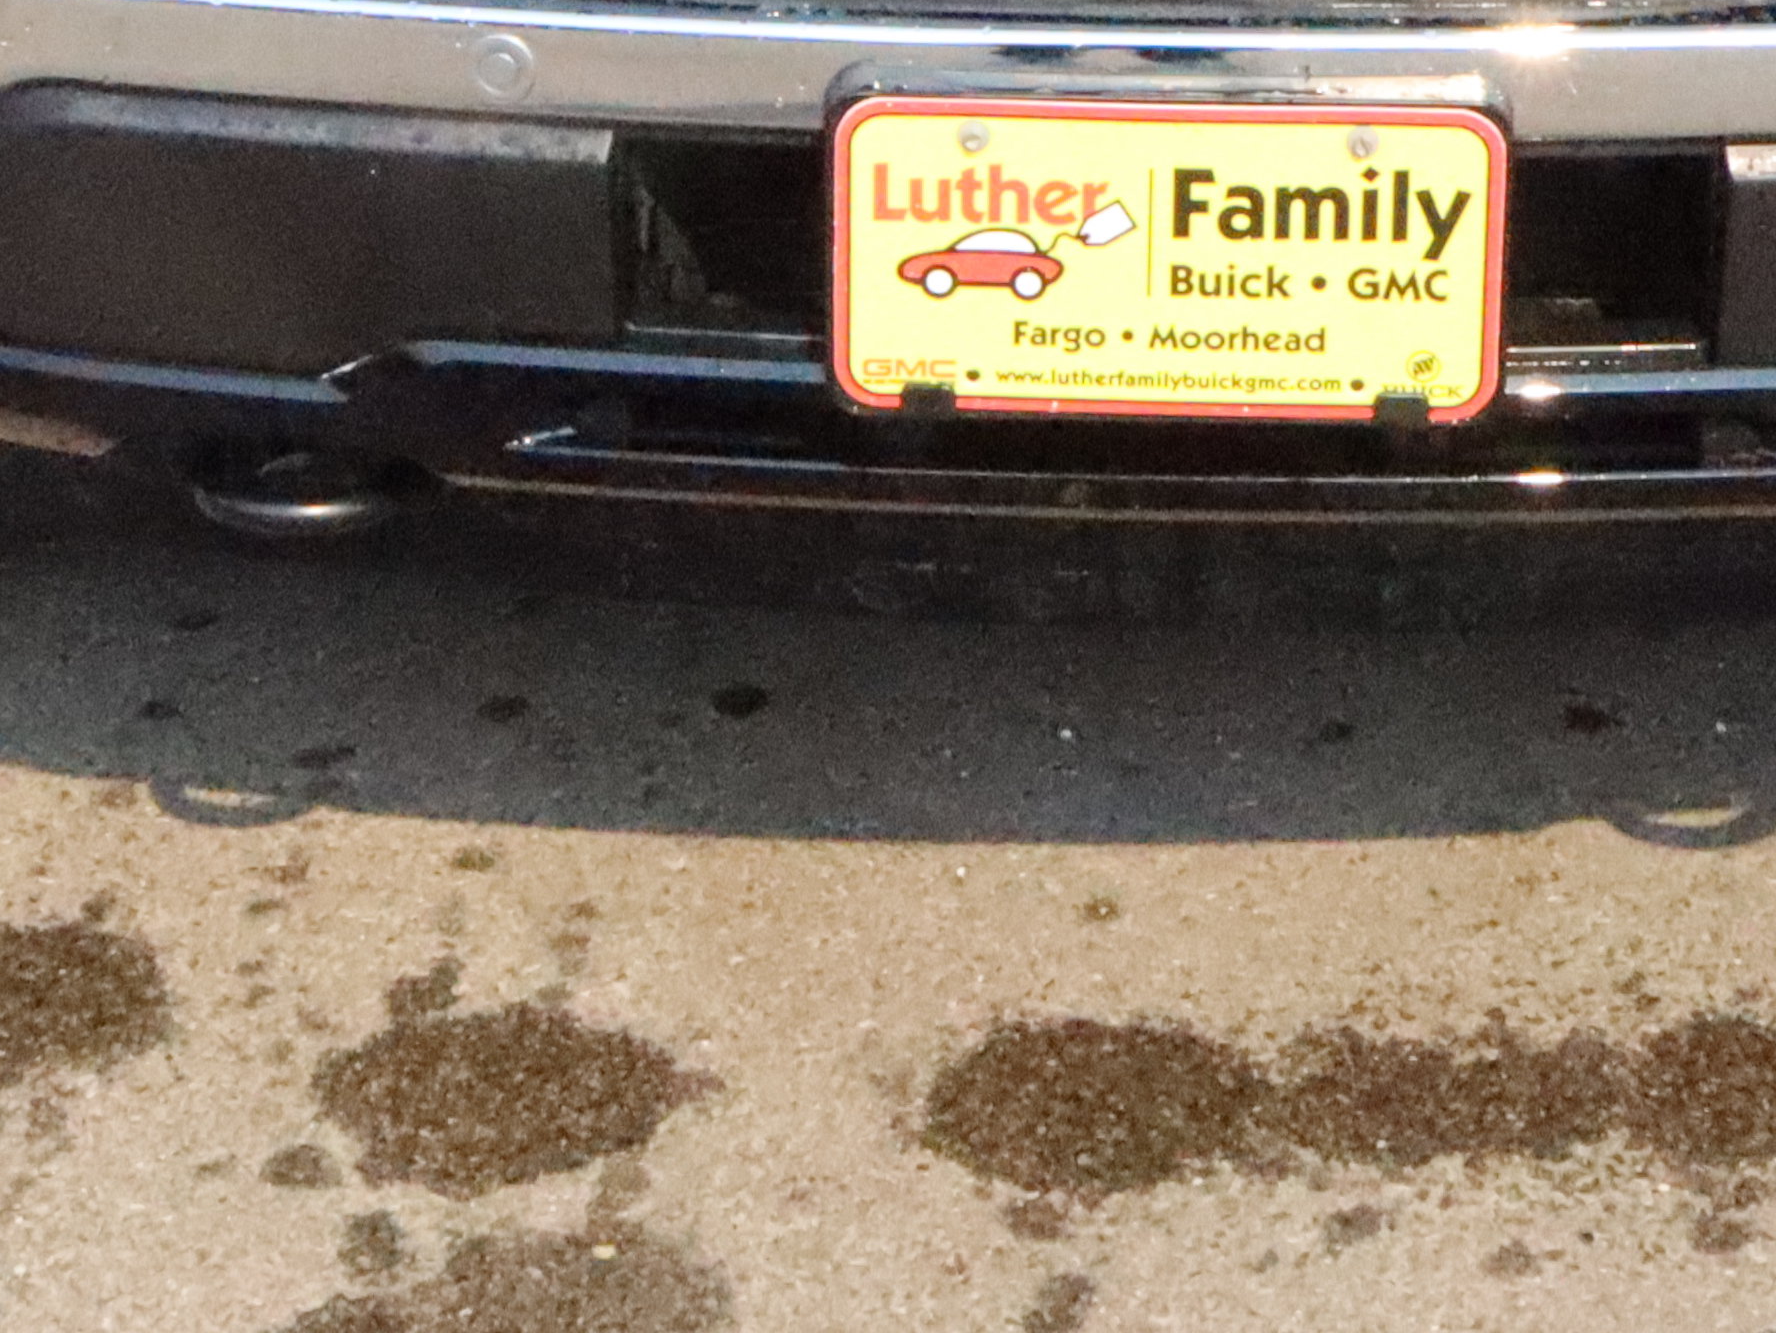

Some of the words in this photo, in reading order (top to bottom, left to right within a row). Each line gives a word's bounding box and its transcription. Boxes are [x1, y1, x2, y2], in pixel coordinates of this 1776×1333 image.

[873, 163, 1108, 225] Luther
[1172, 166, 1472, 261] Family
[1170, 264, 1291, 299] Buick
[1347, 267, 1449, 302] GMC
[1013, 321, 1106, 353] Fargo
[1149, 324, 1326, 353] Moorhead
[862, 358, 957, 378] GMC
[995, 366, 1342, 393] www.lutherfamilybuickgmc.com
